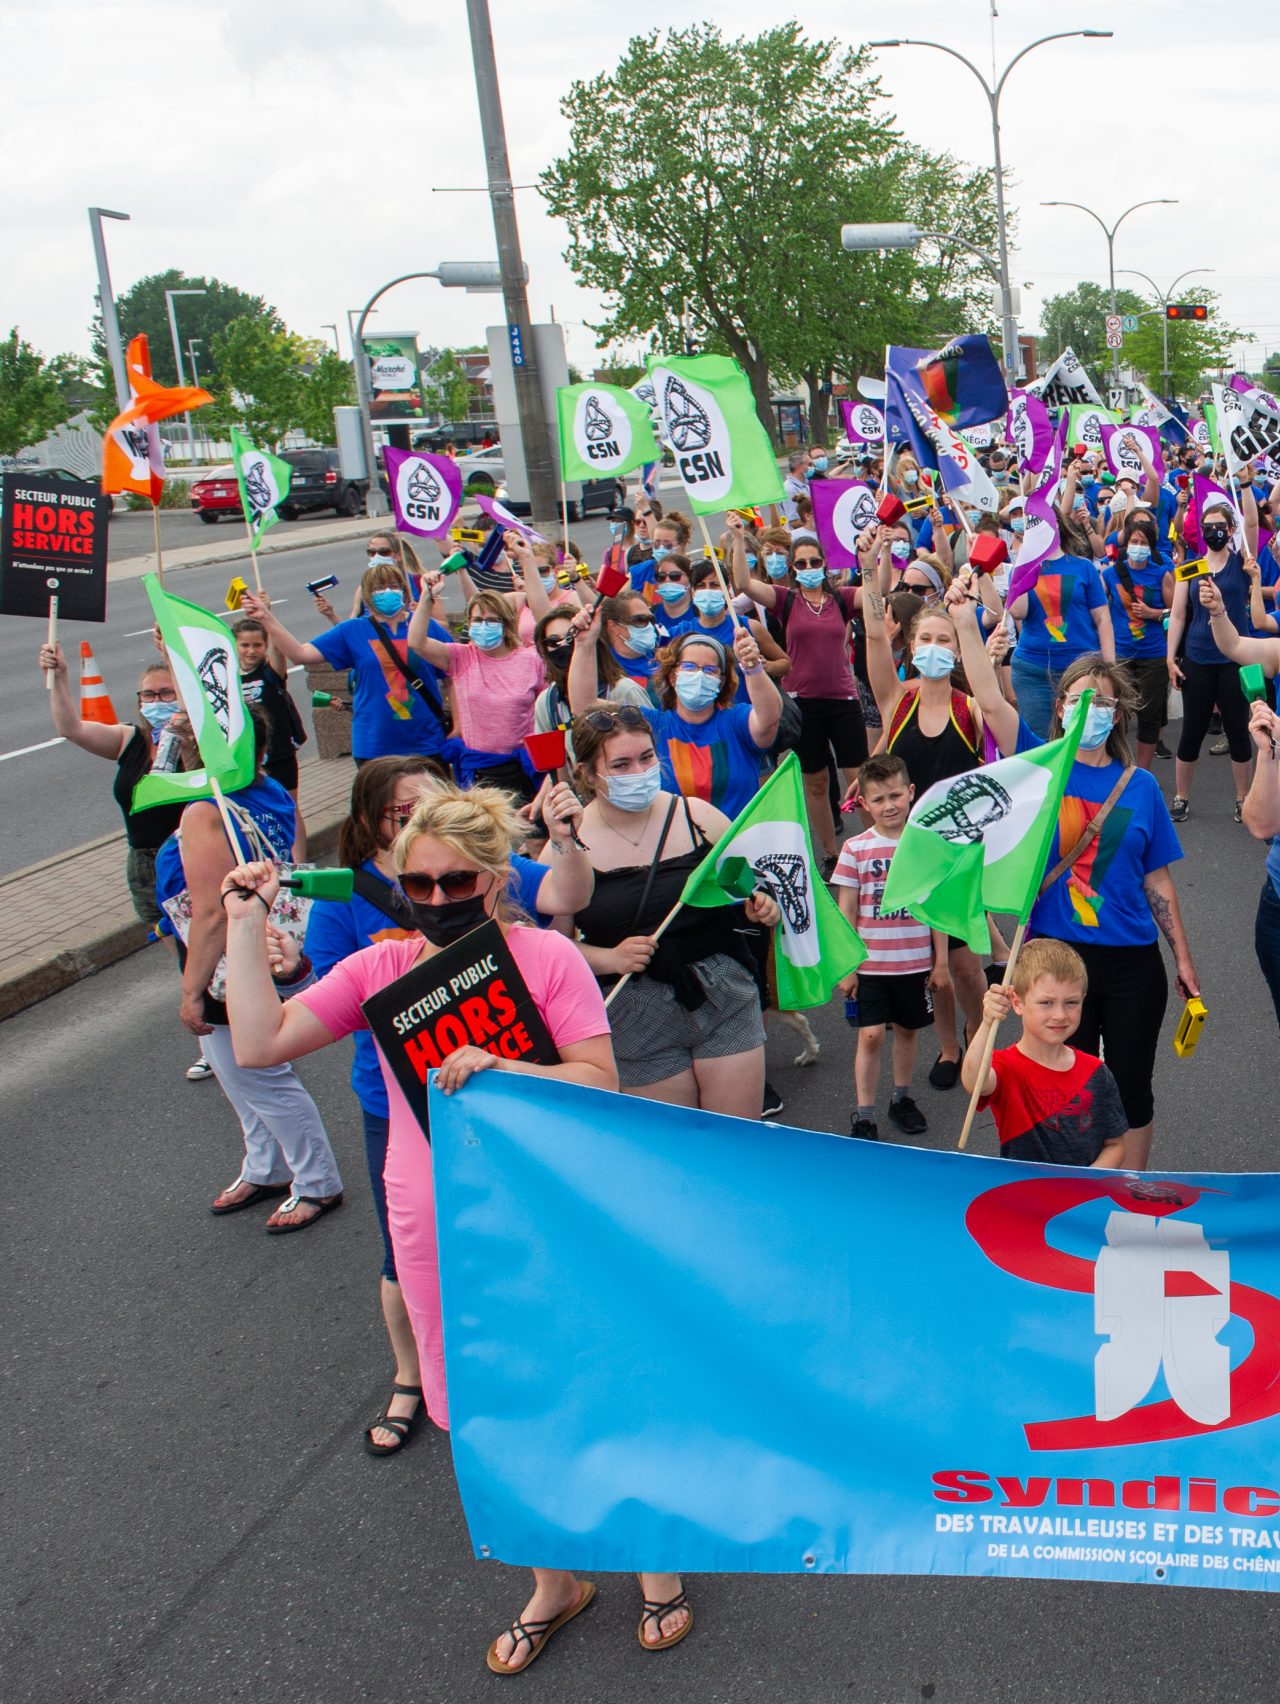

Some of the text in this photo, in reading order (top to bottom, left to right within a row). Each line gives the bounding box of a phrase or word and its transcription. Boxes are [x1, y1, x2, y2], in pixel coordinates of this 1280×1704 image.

[861, 426, 881, 435] CSN
[586, 441, 620, 460] CSN
[678, 451, 726, 485] CSN
[15, 488, 97, 508] SECTEUR PUBLIC
[13, 503, 95, 537] HORS
[406, 502, 440, 521] CSN
[12, 531, 94, 555] SERVICE
[392, 954, 498, 1035] SECTEUR PUBLIC
[403, 979, 517, 1086] HORS
[935, 1513, 975, 1533] DES
[979, 1514, 1146, 1541] TRAVAILLEUSES
[1153, 1522, 1179, 1542] ET
[1184, 1524, 1224, 1545] DES
[988, 1544, 1007, 1557] DE
[1010, 1545, 1029, 1559] LA
[1033, 1545, 1126, 1563] COMMISSION
[1129, 1549, 1199, 1569] SCOLAIRE
[1202, 1556, 1230, 1570] DES
